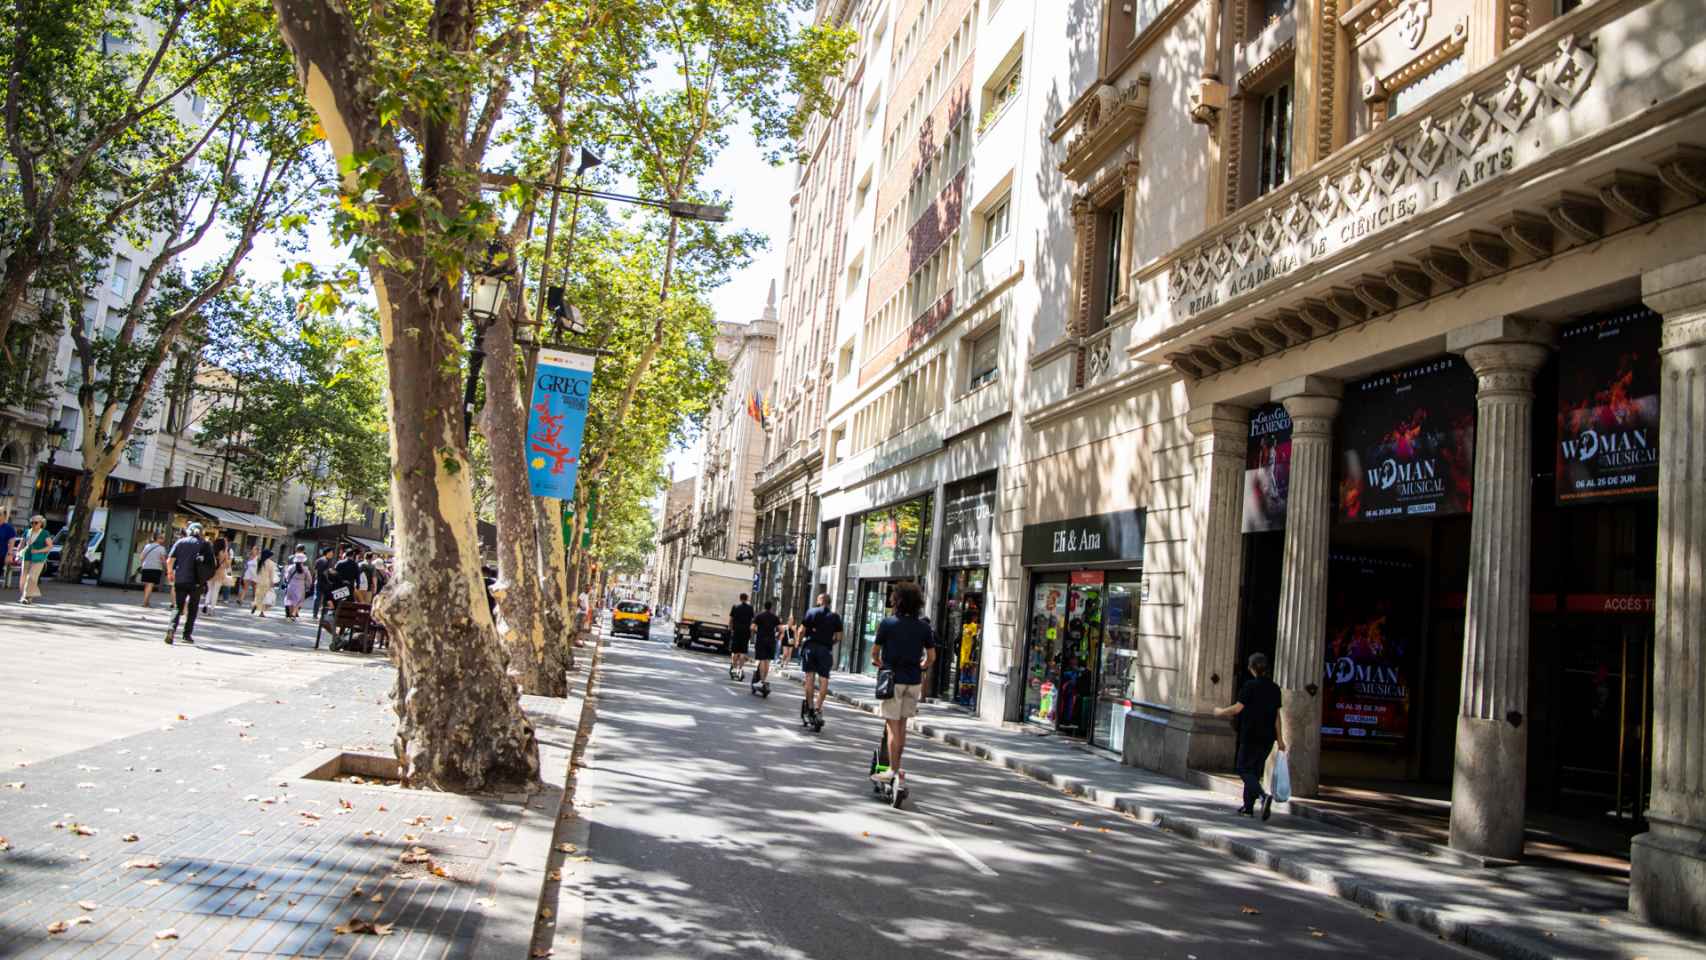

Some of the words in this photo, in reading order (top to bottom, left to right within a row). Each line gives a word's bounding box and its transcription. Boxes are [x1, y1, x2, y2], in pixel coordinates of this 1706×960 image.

[1189, 289, 1220, 315] REIAL
[1310, 237, 1328, 257] DE
[1432, 181, 1439, 201] I
[1455, 145, 1513, 192] ARTS
[537, 374, 589, 397] GREC
[1561, 428, 1647, 461] WOMAN
[1367, 458, 1436, 489] WOMAN
[1401, 478, 1445, 496] MUSICAL
[1053, 530, 1066, 552] Eli
[1067, 529, 1077, 551] &
[1079, 528, 1101, 551] Ana
